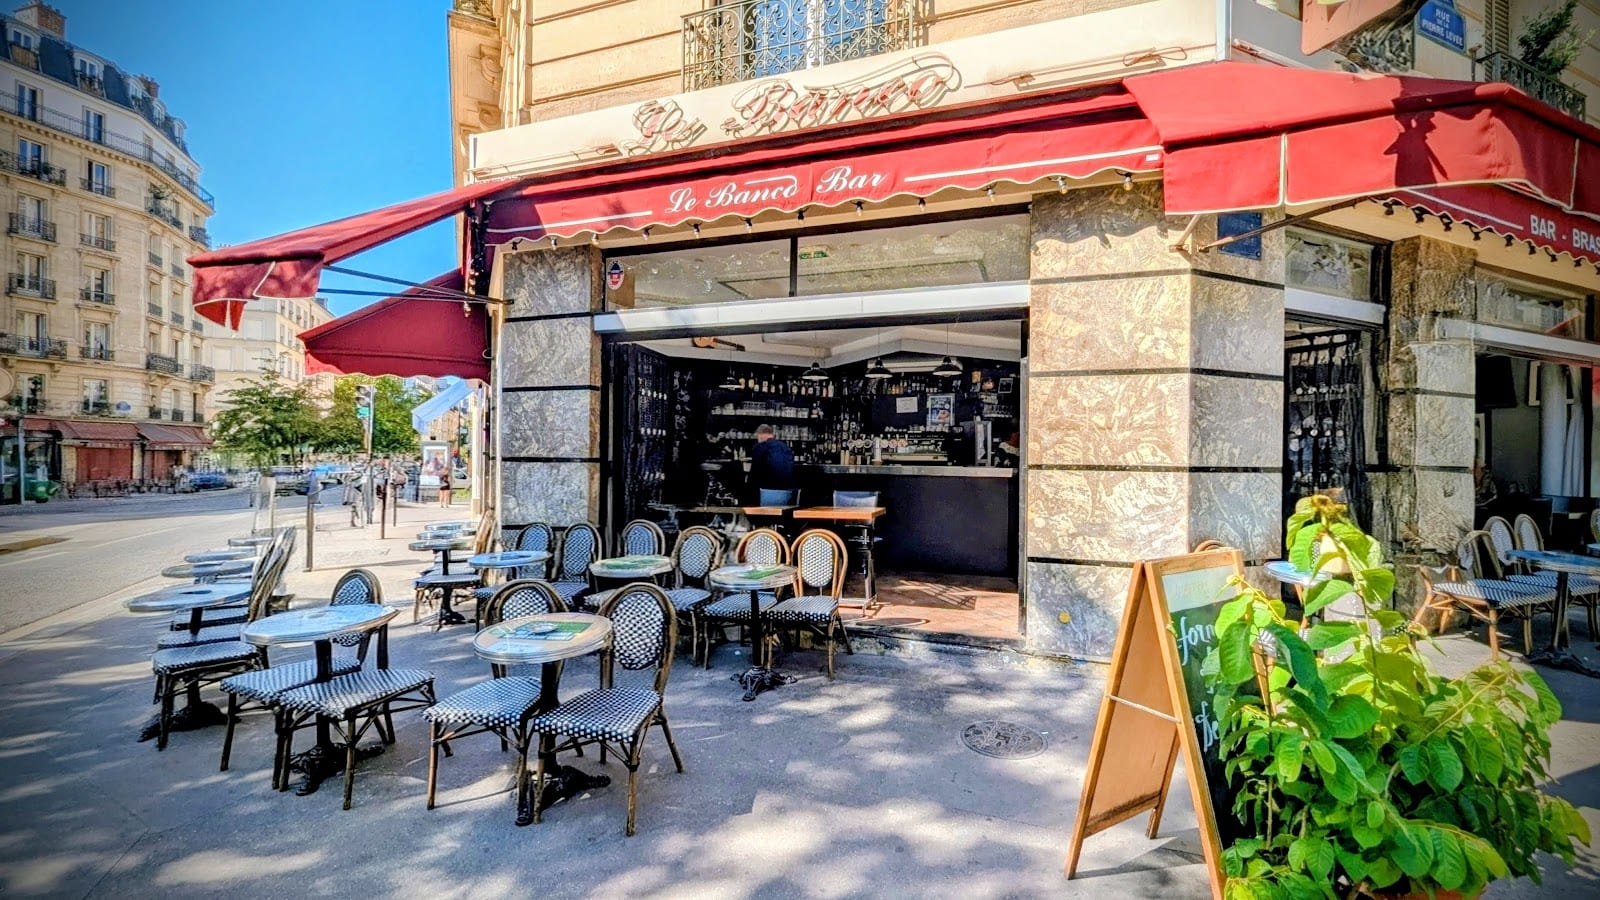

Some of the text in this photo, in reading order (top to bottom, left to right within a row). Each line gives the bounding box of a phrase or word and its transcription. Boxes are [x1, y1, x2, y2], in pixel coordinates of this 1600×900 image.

[1422, 19, 1445, 36] PIERRE
[1436, 9, 1450, 23] RUE
[620, 51, 962, 156] Le Banco
[664, 165, 888, 214] Le Banco Bar
[1530, 214, 1556, 241] BAR
